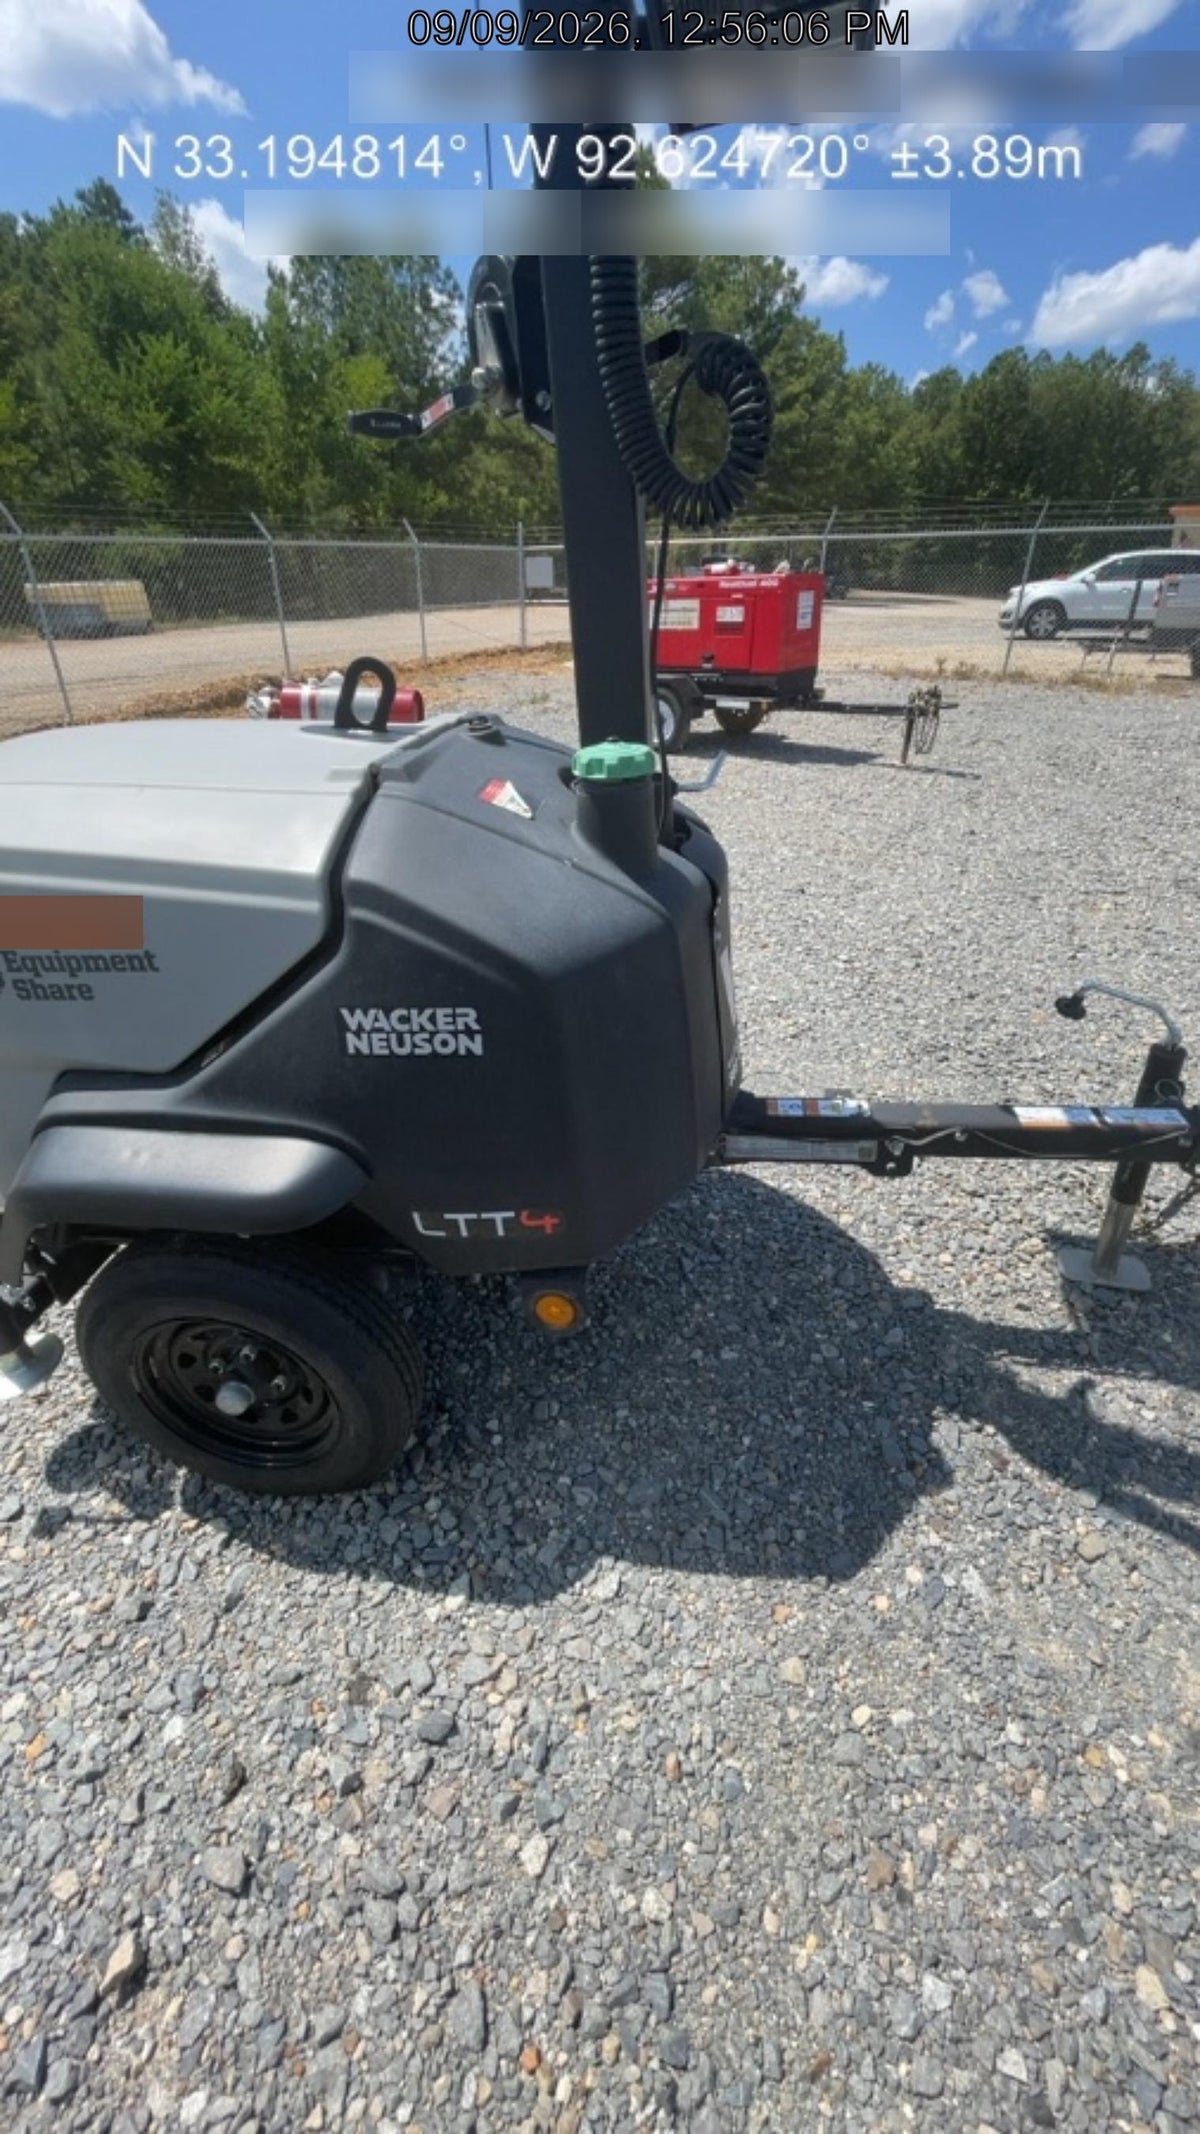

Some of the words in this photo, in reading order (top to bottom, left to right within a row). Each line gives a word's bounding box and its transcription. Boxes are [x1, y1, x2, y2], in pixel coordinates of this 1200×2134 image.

[1, 950, 160, 978] Equipment
[12, 978, 96, 1001] Share
[338, 1007, 482, 1032] WACKER
[345, 1031, 484, 1056] NEUSON
